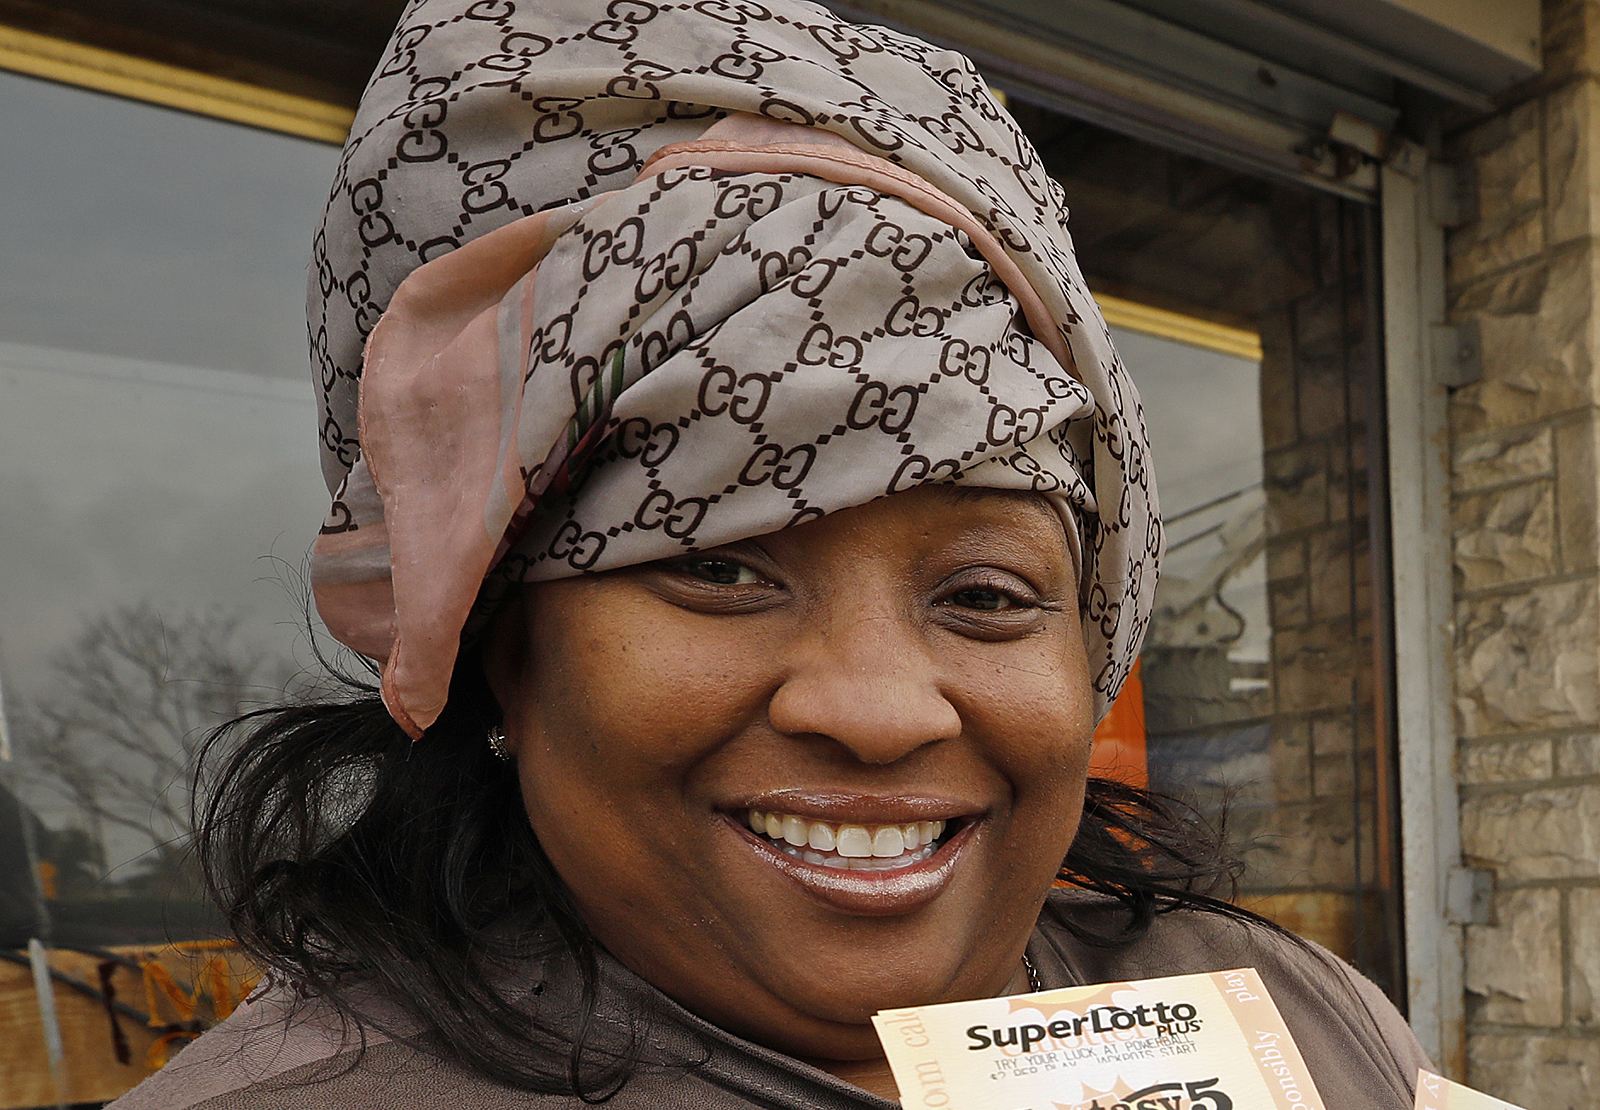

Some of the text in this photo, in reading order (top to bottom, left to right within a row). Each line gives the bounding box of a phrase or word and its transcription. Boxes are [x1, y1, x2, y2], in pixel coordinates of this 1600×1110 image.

[967, 1002, 1197, 1052] SuperLotto
[1157, 1021, 1202, 1037] PLUS
[994, 1058, 1018, 1071] TRY
[1025, 1053, 1058, 1066] YOUR
[1066, 1047, 1096, 1061] LUCK
[1104, 1044, 1119, 1055] AT
